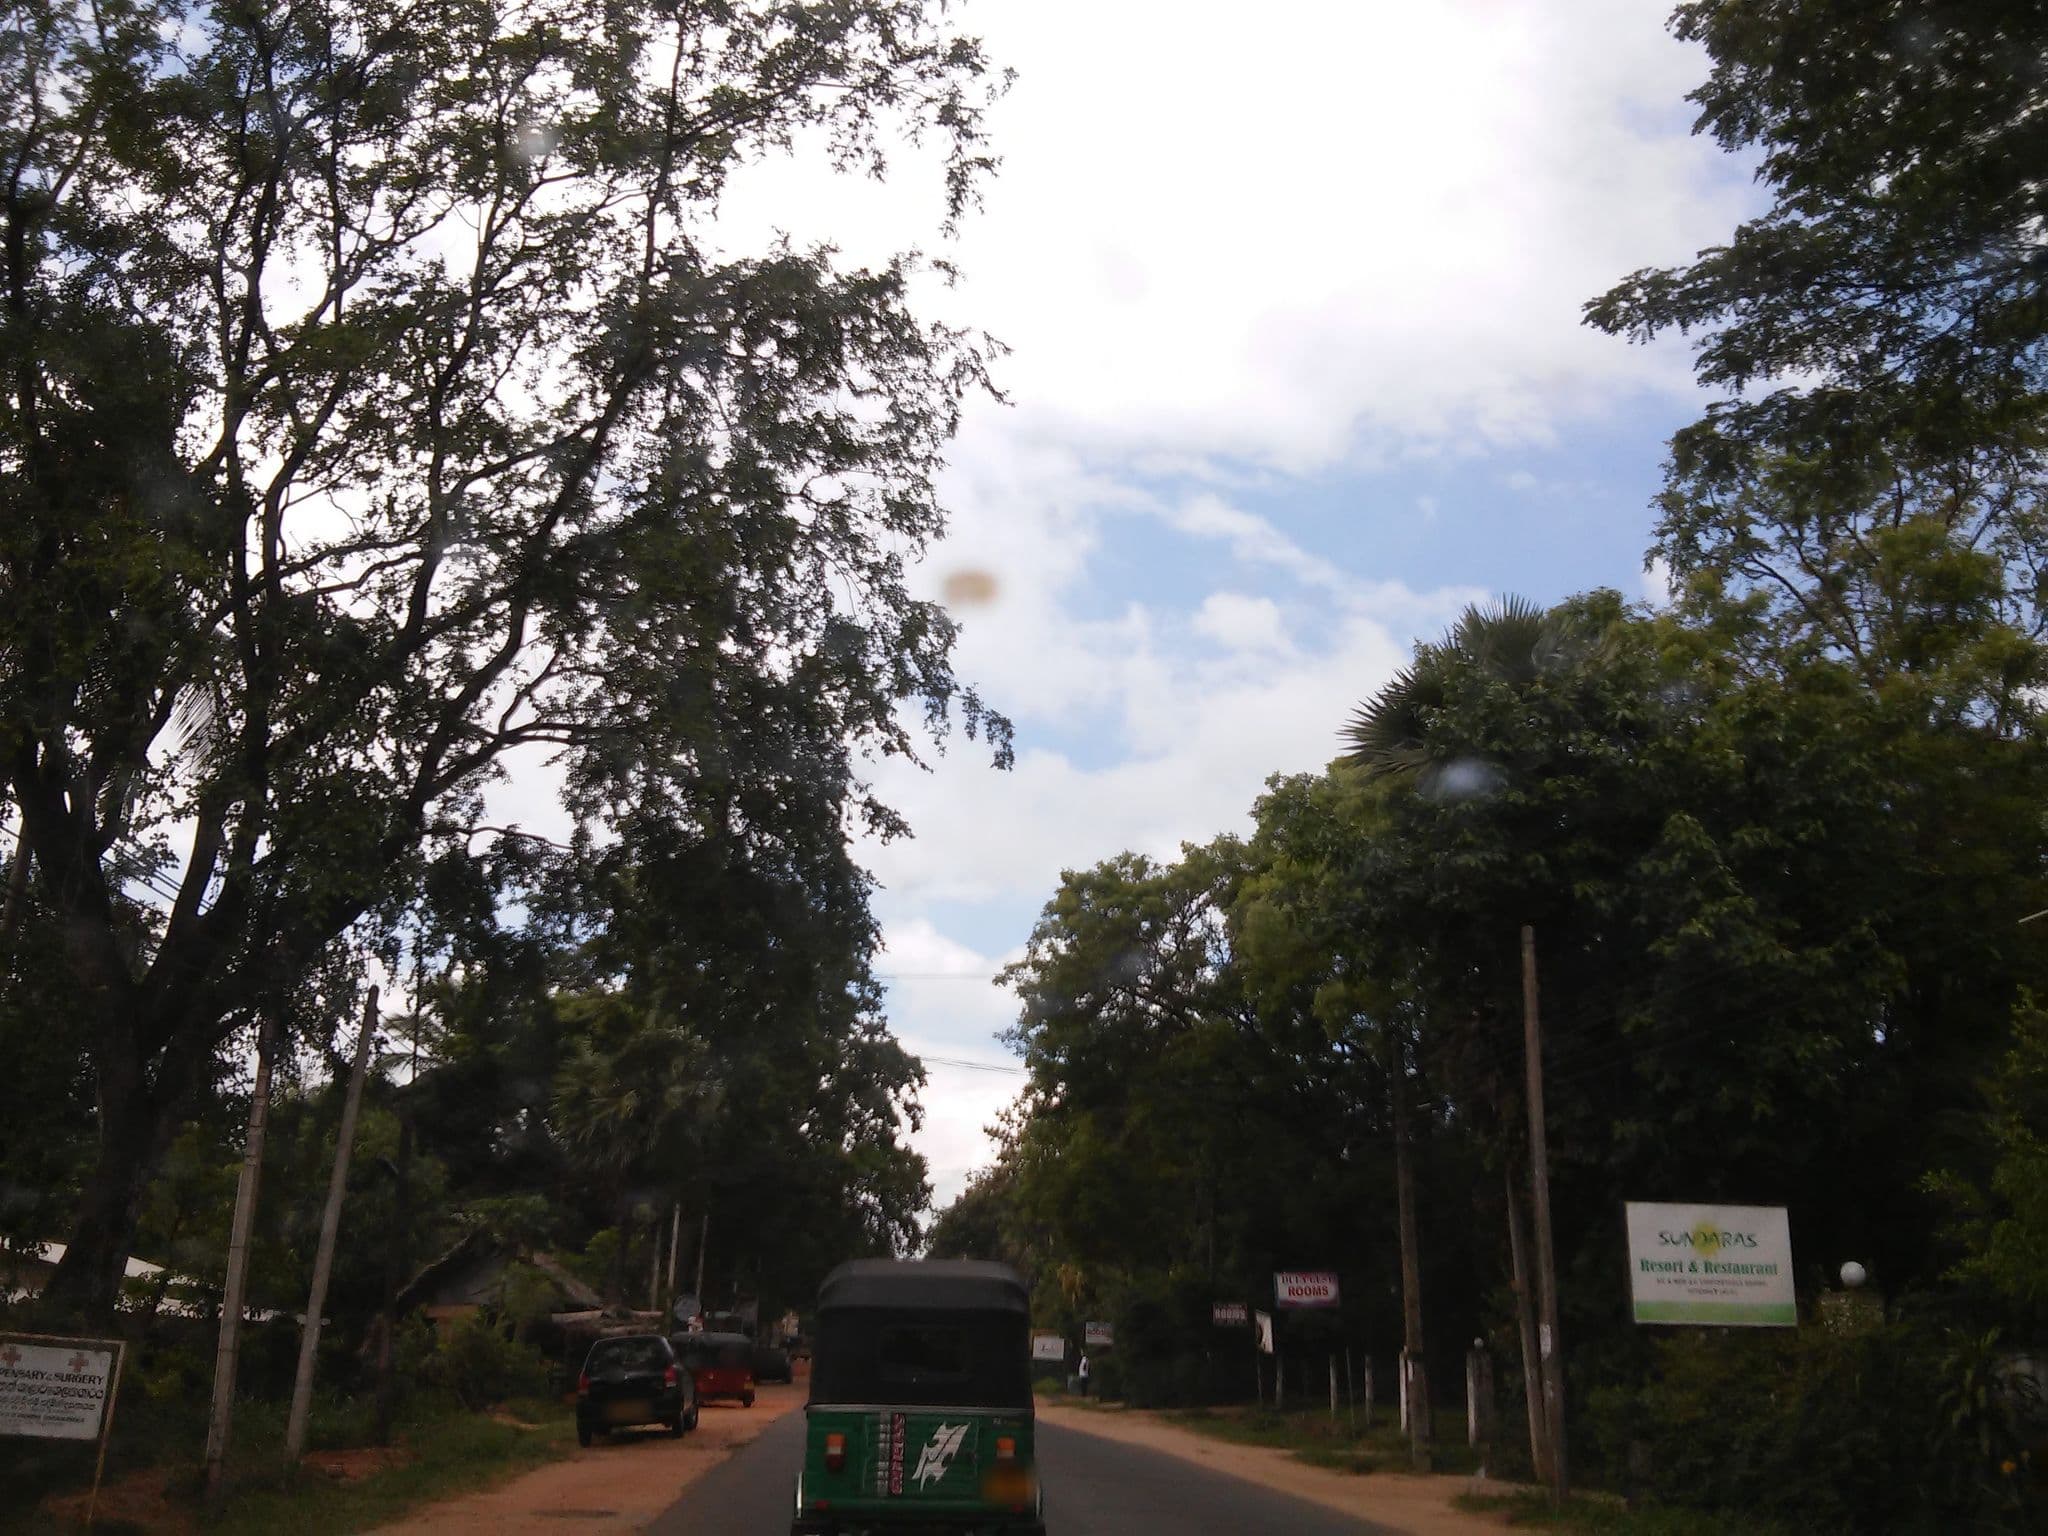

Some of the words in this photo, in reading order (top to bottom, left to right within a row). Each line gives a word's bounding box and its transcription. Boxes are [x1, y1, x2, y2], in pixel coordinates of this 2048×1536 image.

[1640, 1258, 1683, 1273] Resort
[1688, 1260, 1698, 1274] &
[1704, 1260, 1778, 1276] Restaurant
[1288, 1285, 1329, 1297] ROOMS
[54, 1372, 105, 1385] SURGERY
